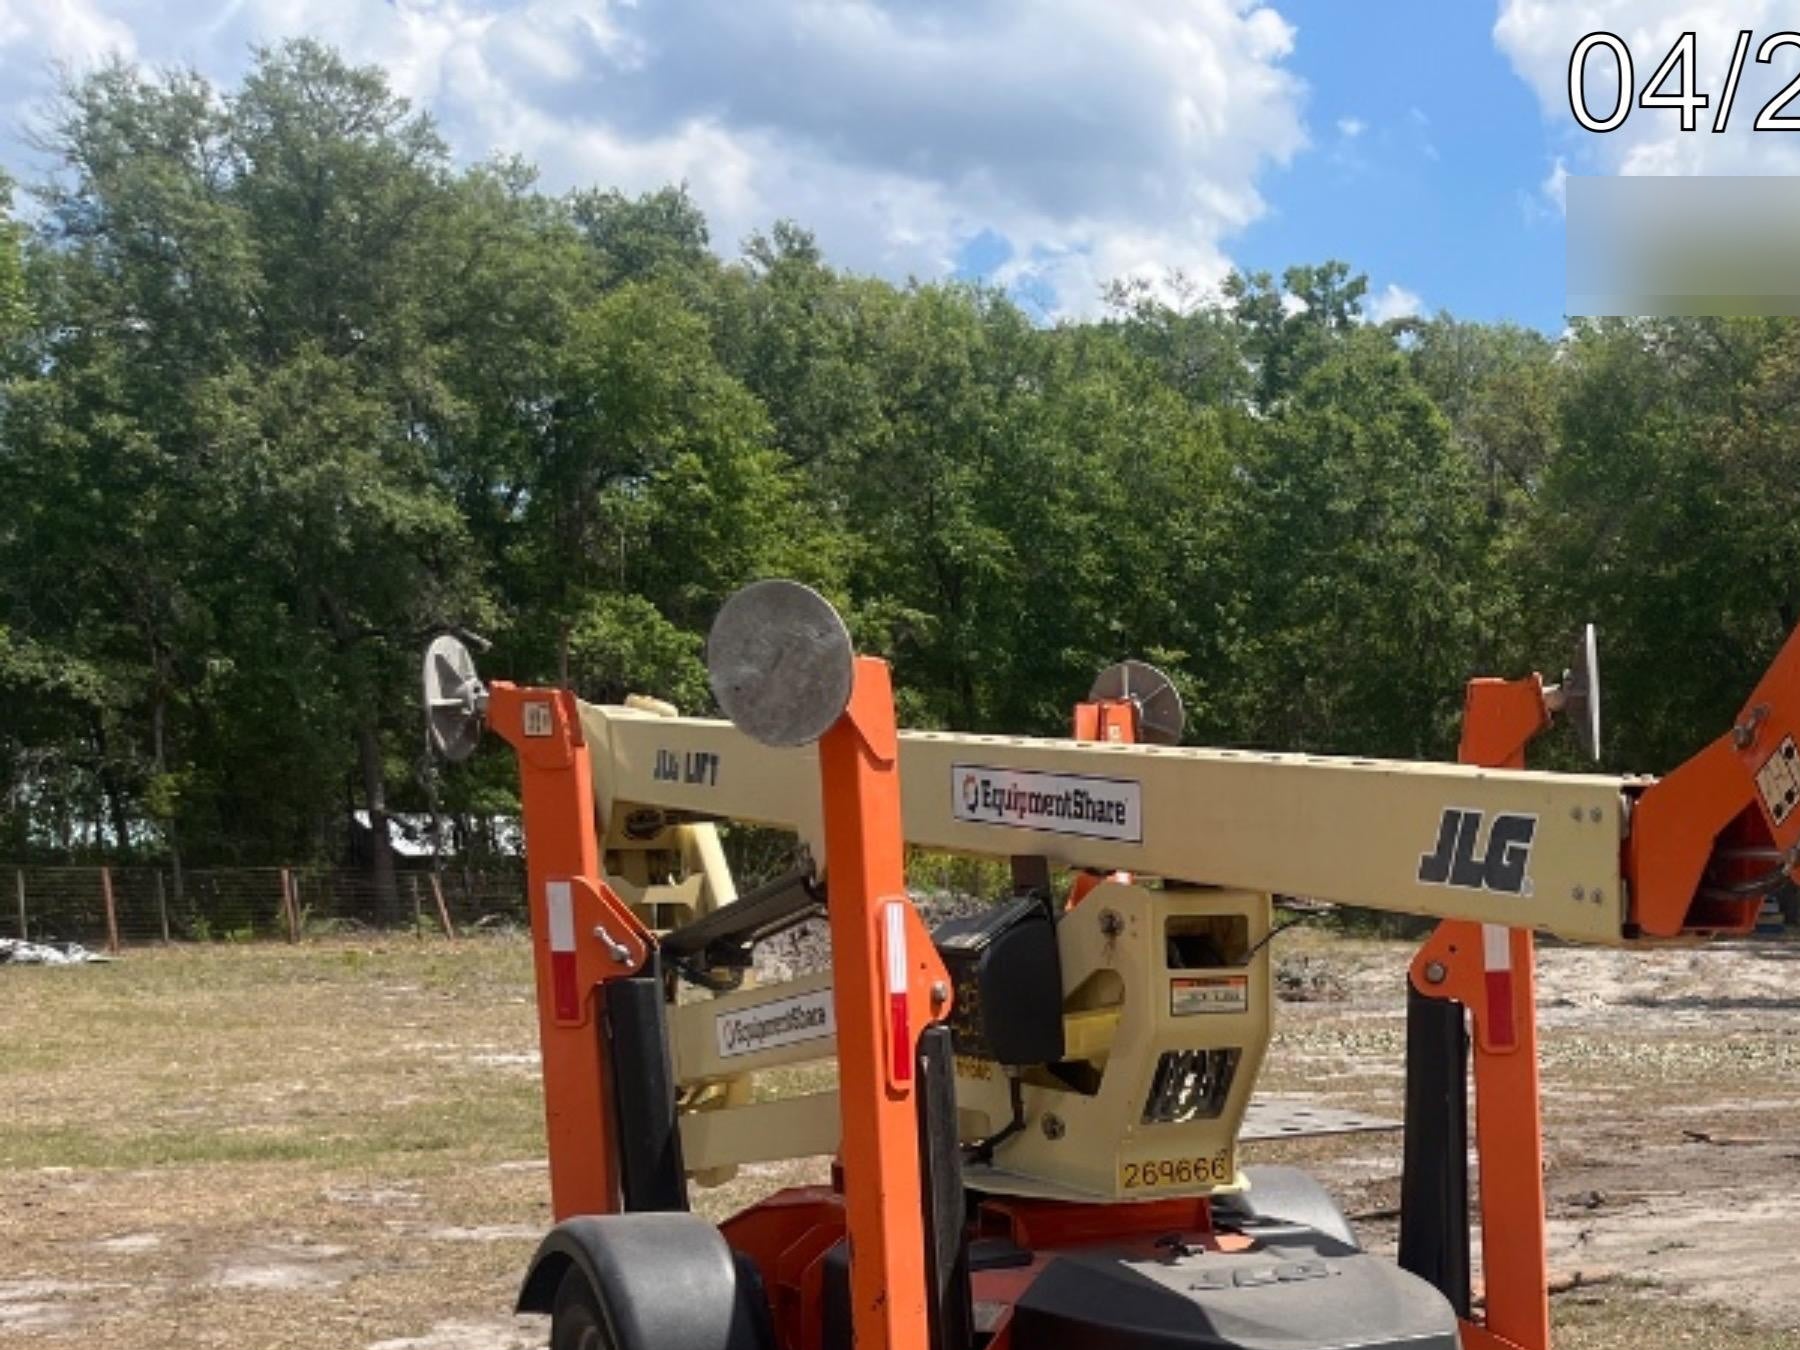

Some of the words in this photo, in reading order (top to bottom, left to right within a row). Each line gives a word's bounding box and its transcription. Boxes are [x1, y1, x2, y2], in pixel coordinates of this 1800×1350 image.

[980, 778, 1127, 826] EquipmentShare
[1416, 806, 1539, 897] JLG
[1123, 1156, 1228, 1189] 269666
